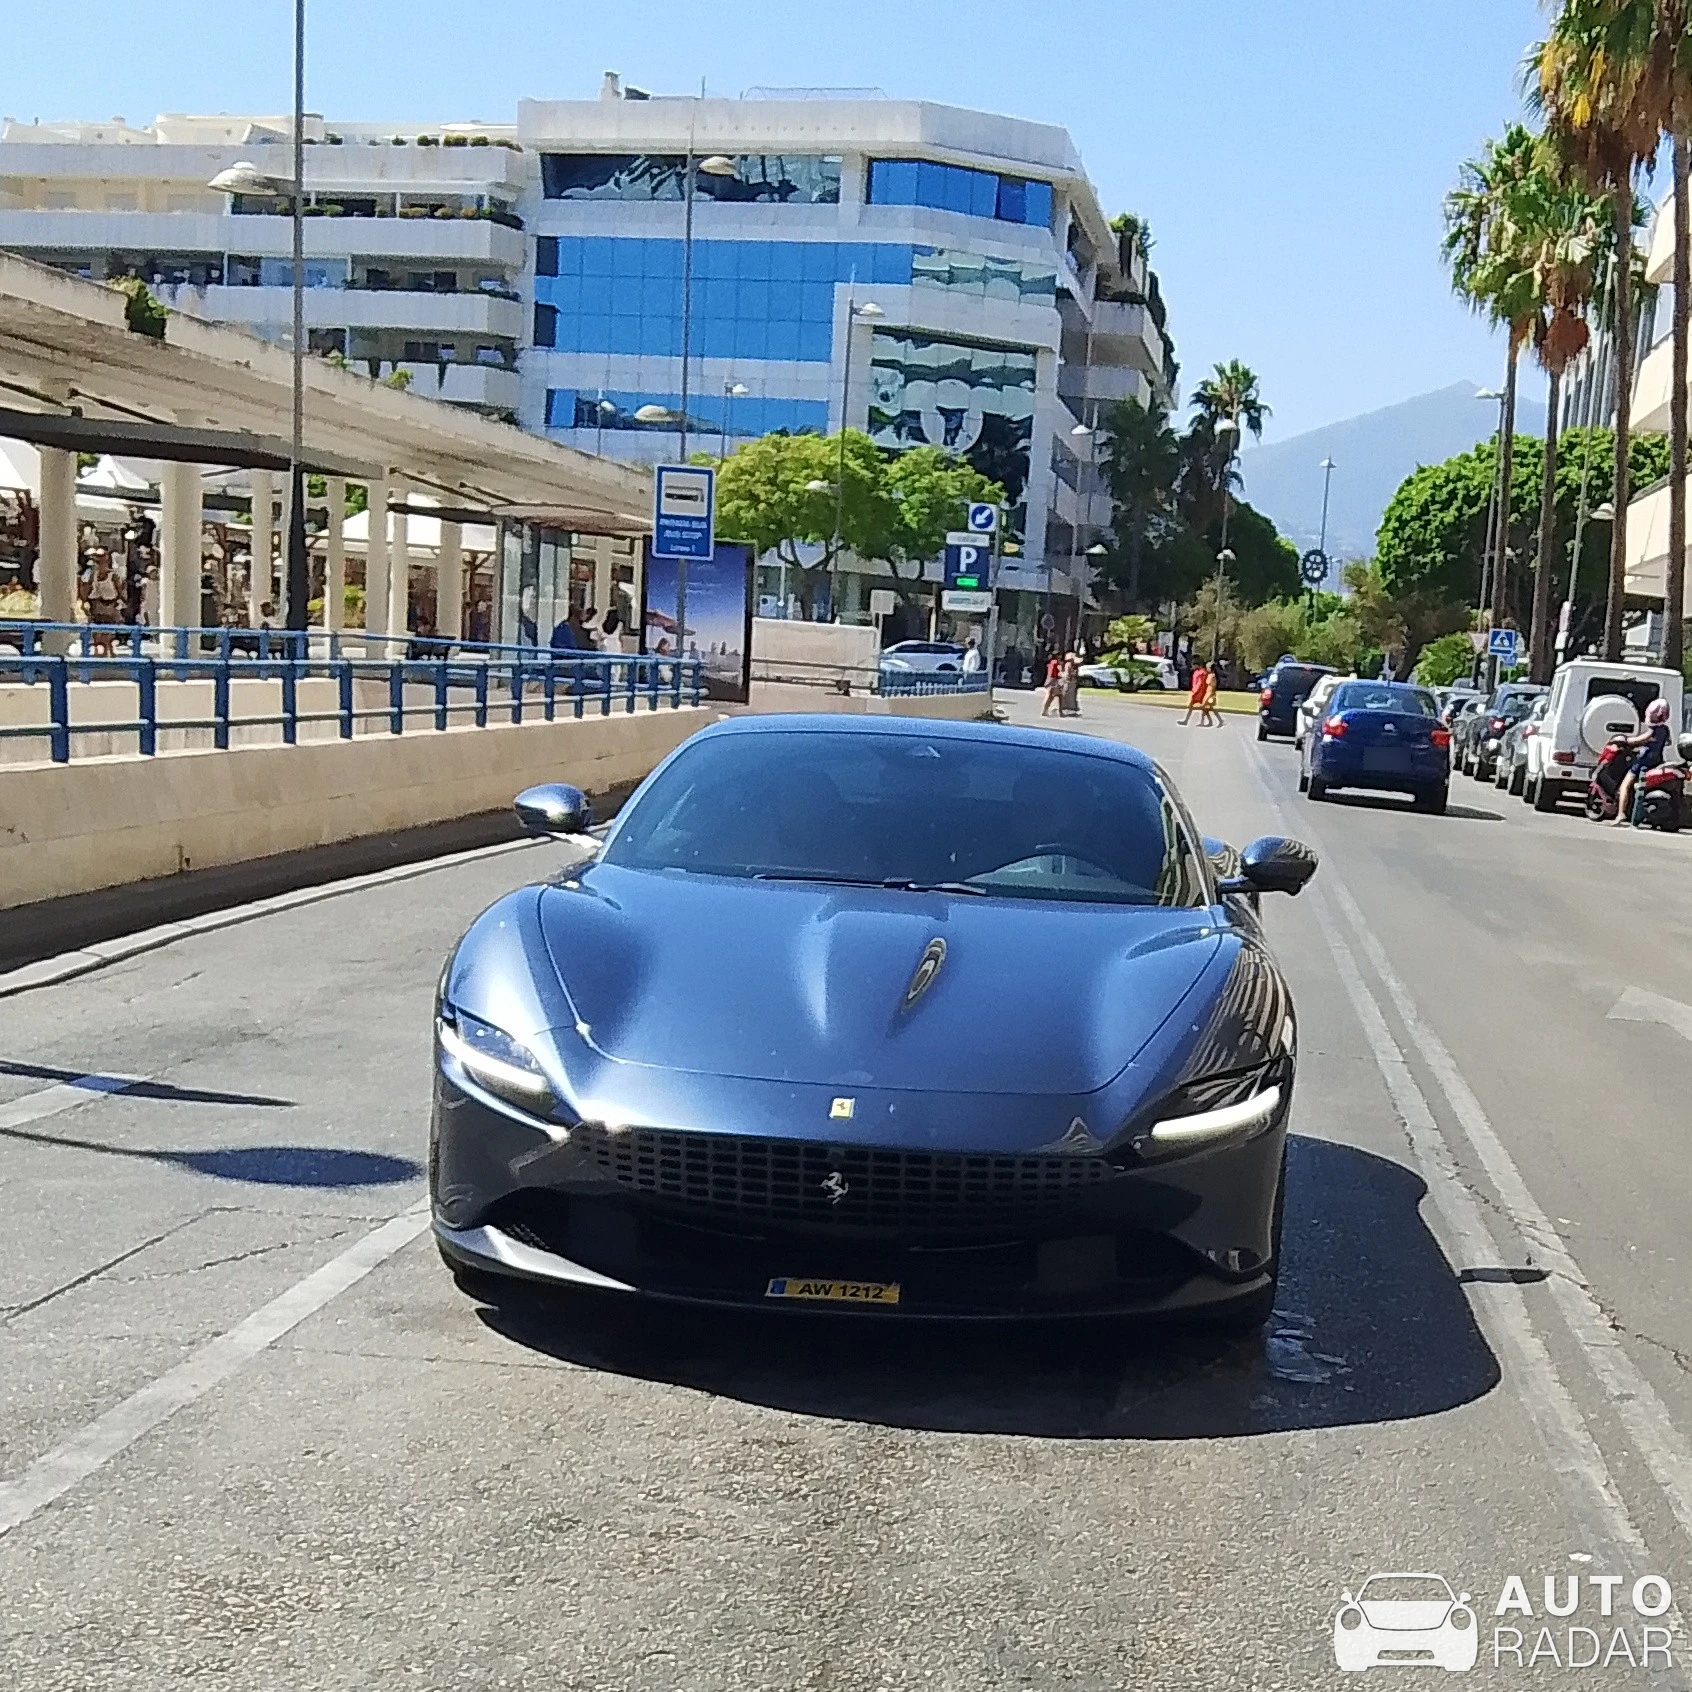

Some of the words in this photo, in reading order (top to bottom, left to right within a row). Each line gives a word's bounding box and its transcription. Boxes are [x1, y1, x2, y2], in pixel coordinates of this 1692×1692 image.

[960, 547, 977, 572] P
[799, 1284, 833, 1295] AW
[840, 1285, 884, 1299] 1212
